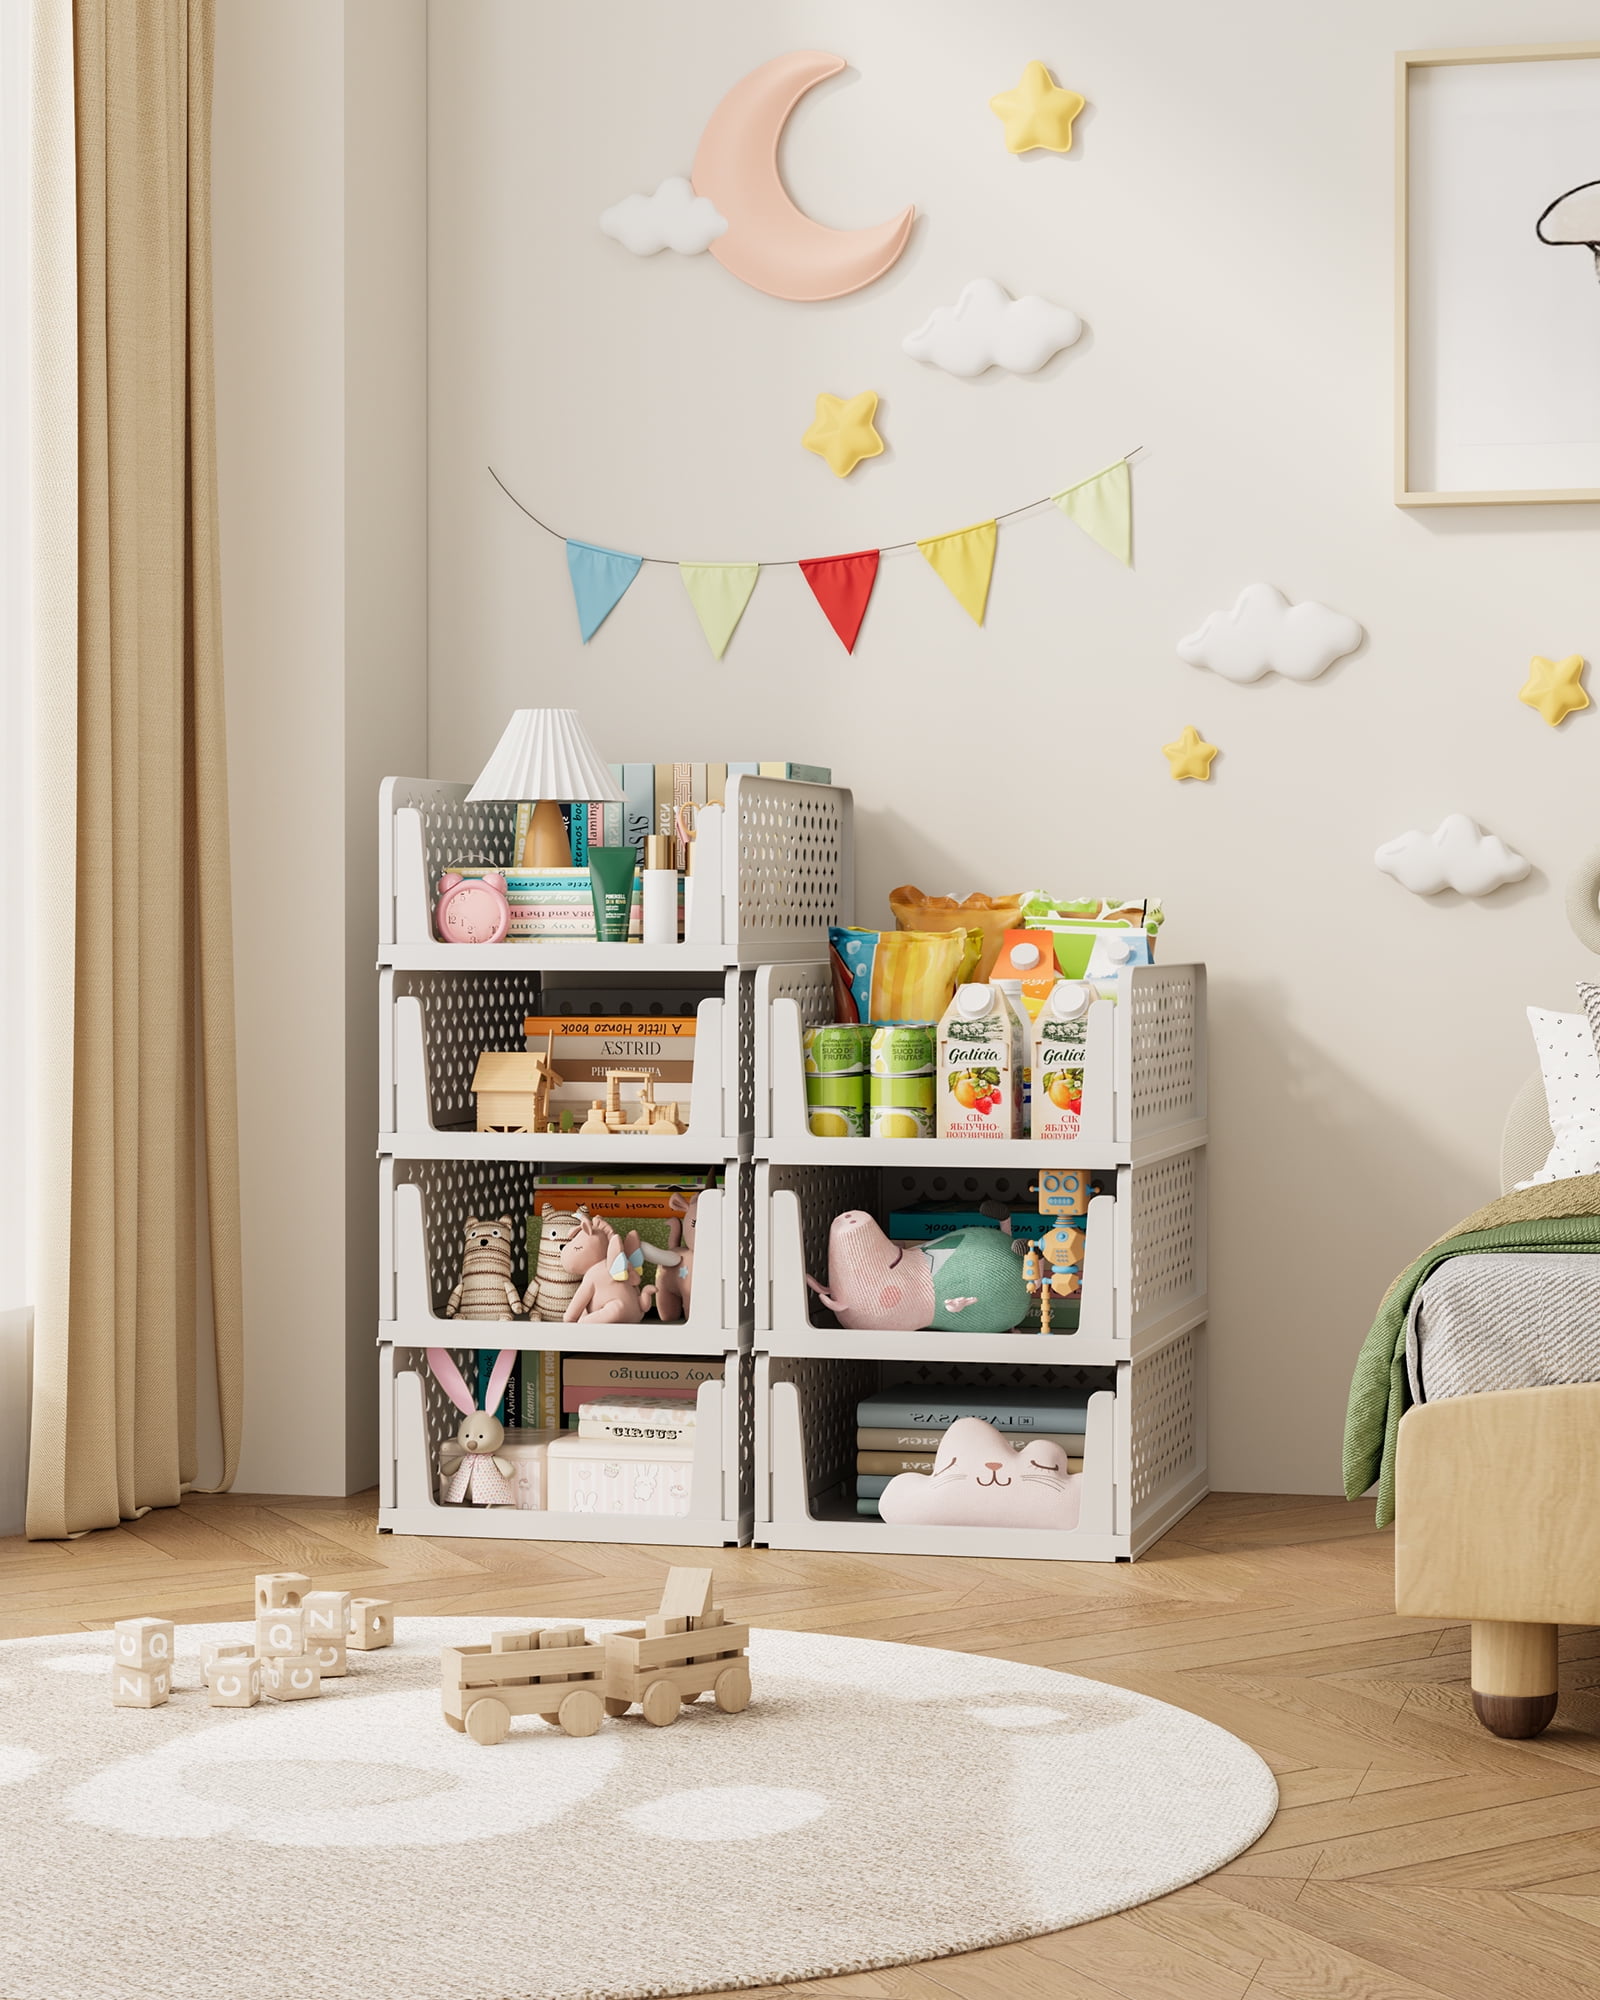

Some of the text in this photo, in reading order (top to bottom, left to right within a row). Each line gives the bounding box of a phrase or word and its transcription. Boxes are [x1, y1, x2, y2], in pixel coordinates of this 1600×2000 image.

[574, 826, 583, 868] sternos
[561, 1023, 682, 1035] A little Honzo book
[609, 1368, 680, 1381] conmigo
[506, 1376, 516, 1415] Animals
[521, 1381, 535, 1425] dreamers
[149, 1633, 168, 1659] Q
[269, 1623, 293, 1650] Q
